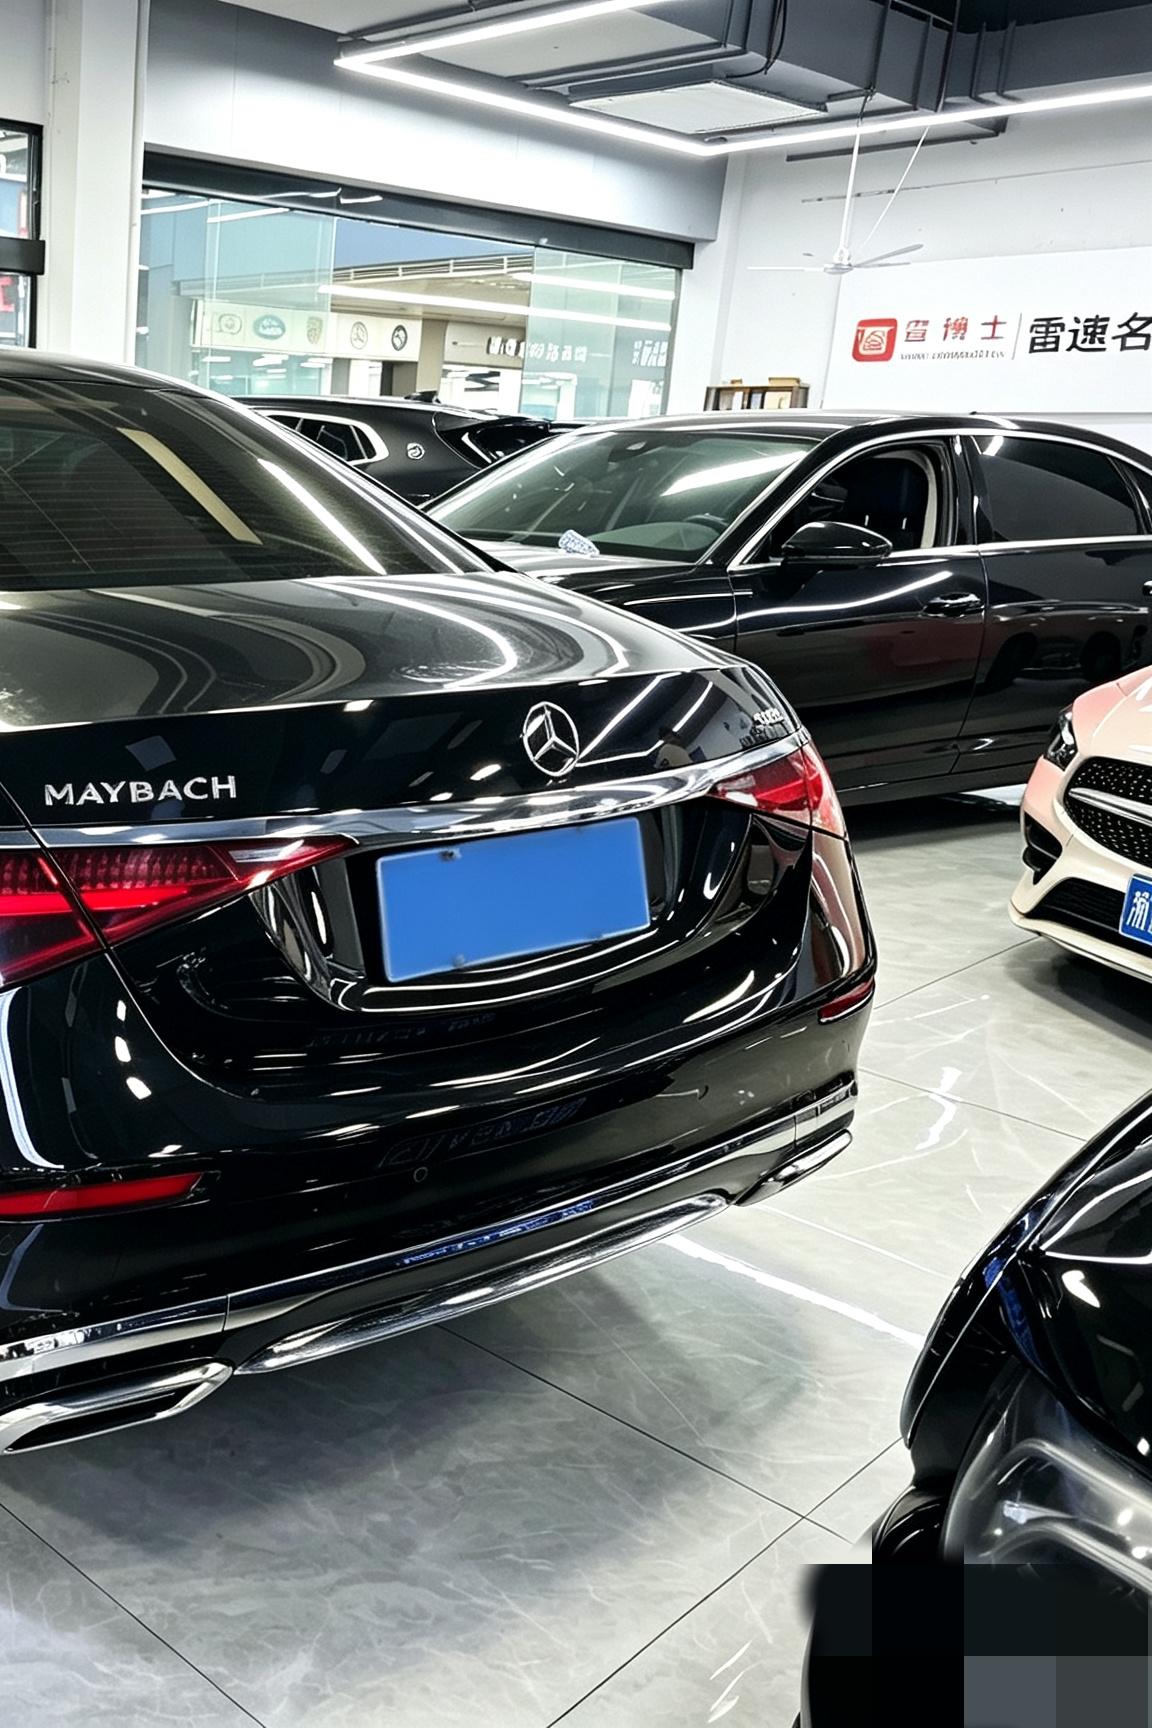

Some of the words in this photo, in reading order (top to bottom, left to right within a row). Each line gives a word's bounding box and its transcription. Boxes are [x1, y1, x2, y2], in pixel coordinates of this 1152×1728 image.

[1028, 312, 1152, 354] 雷速名
[44, 775, 237, 806] MAYBACH
